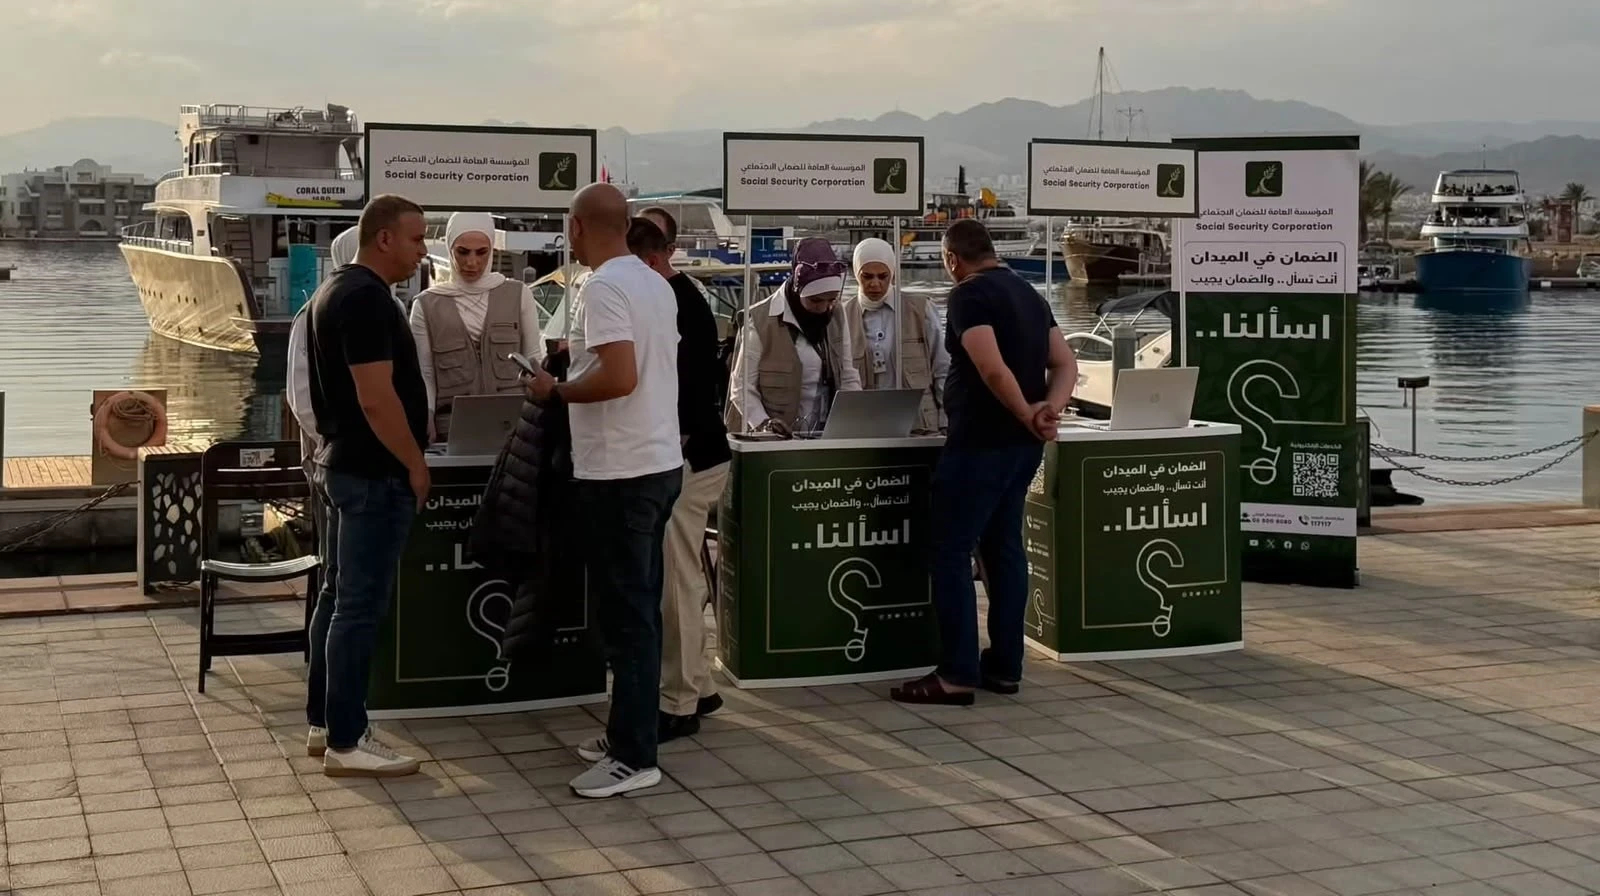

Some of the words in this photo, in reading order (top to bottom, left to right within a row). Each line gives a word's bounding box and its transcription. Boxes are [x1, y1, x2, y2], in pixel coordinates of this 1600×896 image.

[384, 154, 427, 166] الاجتماعي
[428, 155, 461, 166] للضمان
[463, 156, 488, 165] العامة
[490, 157, 530, 168] المؤسسة
[740, 162, 777, 174] الاجتماعي
[778, 163, 806, 172] للضمان
[807, 163, 830, 171] العامة
[830, 164, 866, 173] المؤسسة
[1042, 165, 1075, 176] الاجتماعي
[1075, 166, 1100, 175] للضمان
[1120, 169, 1151, 177] المؤسسة
[384, 170, 417, 180] Social
[419, 171, 464, 182] Security
[466, 171, 530, 183] Corporation
[740, 177, 769, 186] Social
[770, 177, 809, 188] Security
[810, 178, 866, 188] Corporation
[1042, 178, 1067, 187] Social
[1069, 179, 1101, 190] Security
[1103, 181, 1150, 190] Corporation
[296, 187, 320, 195] CORAL
[321, 187, 346, 195] QUEEN
[1235, 208, 1267, 217] للضمان
[1268, 208, 1293, 216] العامة
[1294, 208, 1334, 217] المؤسسة
[1196, 222, 1226, 231] Social
[1228, 222, 1269, 232] Security
[1272, 222, 1333, 232] Corporation
[1190, 251, 1249, 265] الميدان
[1253, 251, 1276, 270] في
[1280, 251, 1338, 265] الضمان
[1190, 275, 1223, 286] يجيب
[1225, 274, 1275, 286] والضمان
[1316, 272, 1338, 284] أنت
[1195, 306, 1330, 340] اسألنا..
[1103, 464, 1146, 478] الميدان
[1149, 464, 1165, 479] في
[1168, 460, 1206, 475] الضمان
[791, 478, 841, 492] الميدان
[844, 477, 862, 494] في
[865, 475, 910, 489] الضمان
[1191, 478, 1207, 489] أنت
[1102, 486, 1128, 495] يجيب
[1129, 483, 1165, 495] والضمان
[425, 495, 482, 509] الميدان
[791, 501, 819, 511] يجيب
[820, 498, 862, 510] والضمان
[1103, 498, 1208, 532] اسألنا..
[425, 519, 457, 530] يجيب
[791, 514, 910, 550] اسألنا..
